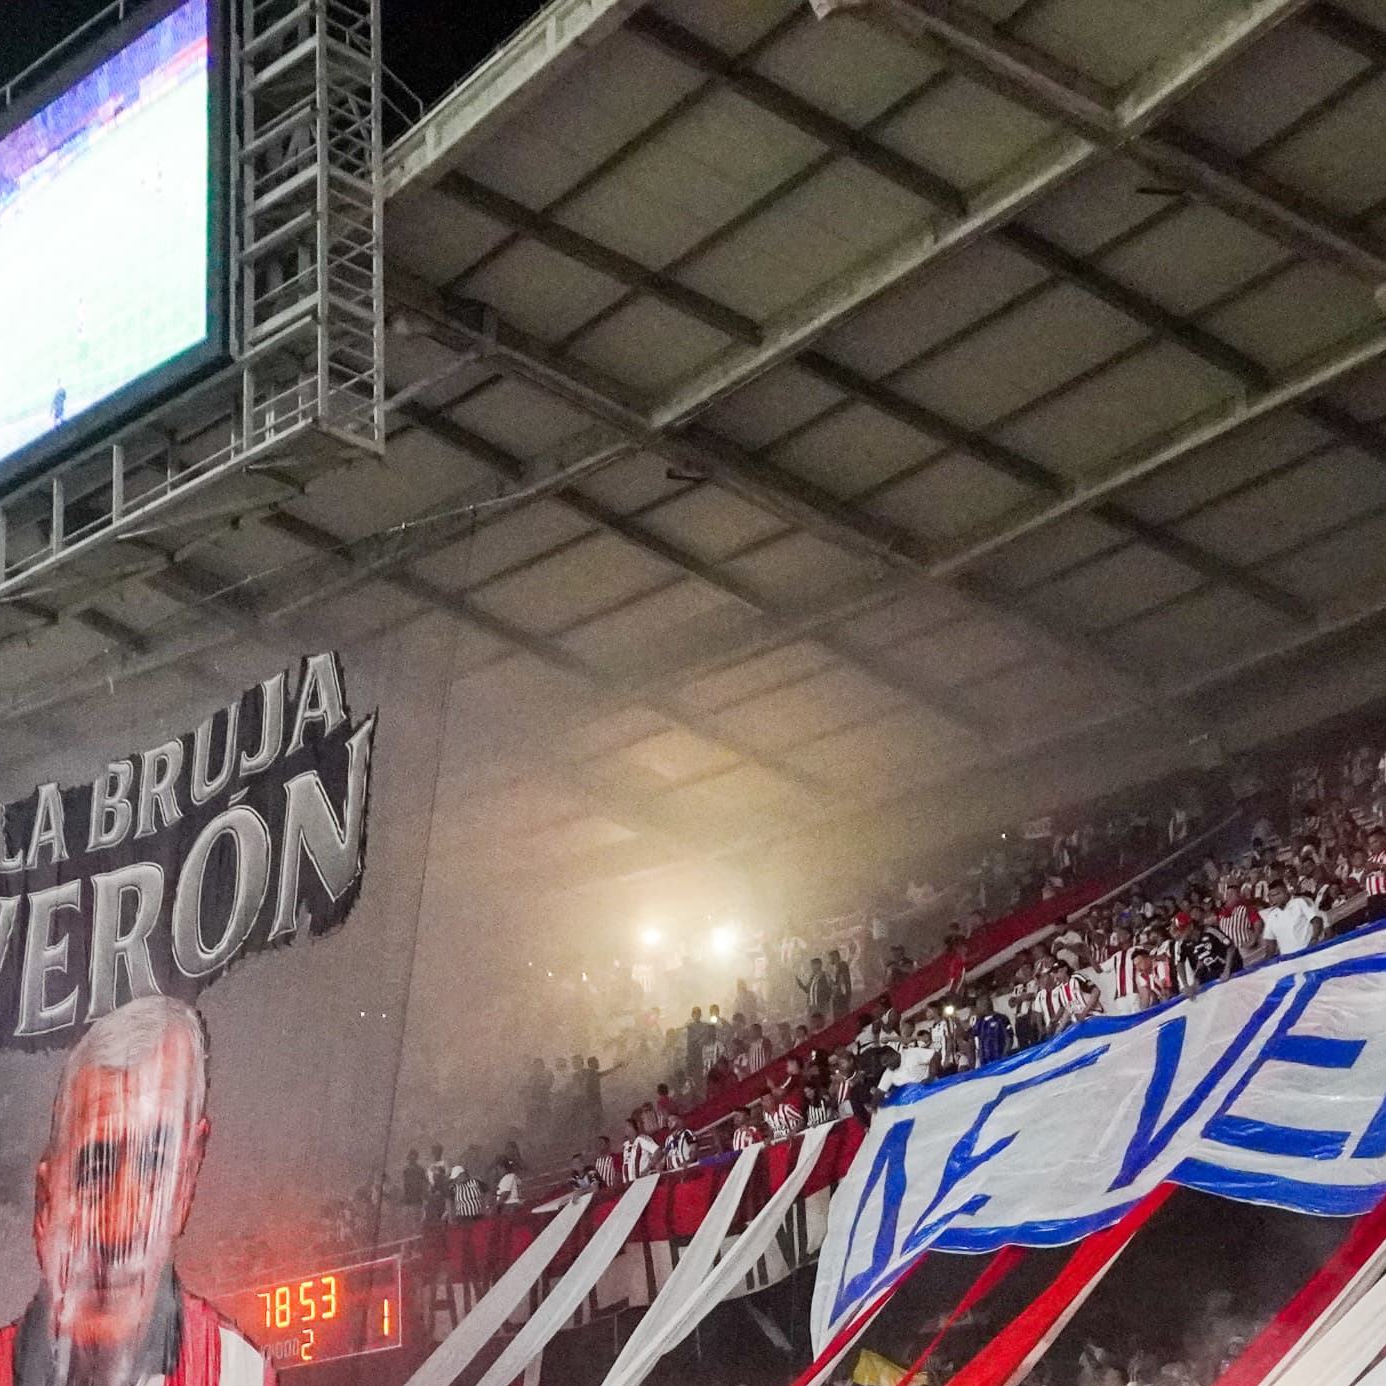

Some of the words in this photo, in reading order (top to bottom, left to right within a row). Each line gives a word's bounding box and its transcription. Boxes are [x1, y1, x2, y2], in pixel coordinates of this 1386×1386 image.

[86, 651, 346, 853] BRUJA
[383, 1299, 389, 1336] 1
[301, 1329, 314, 1360] 2
